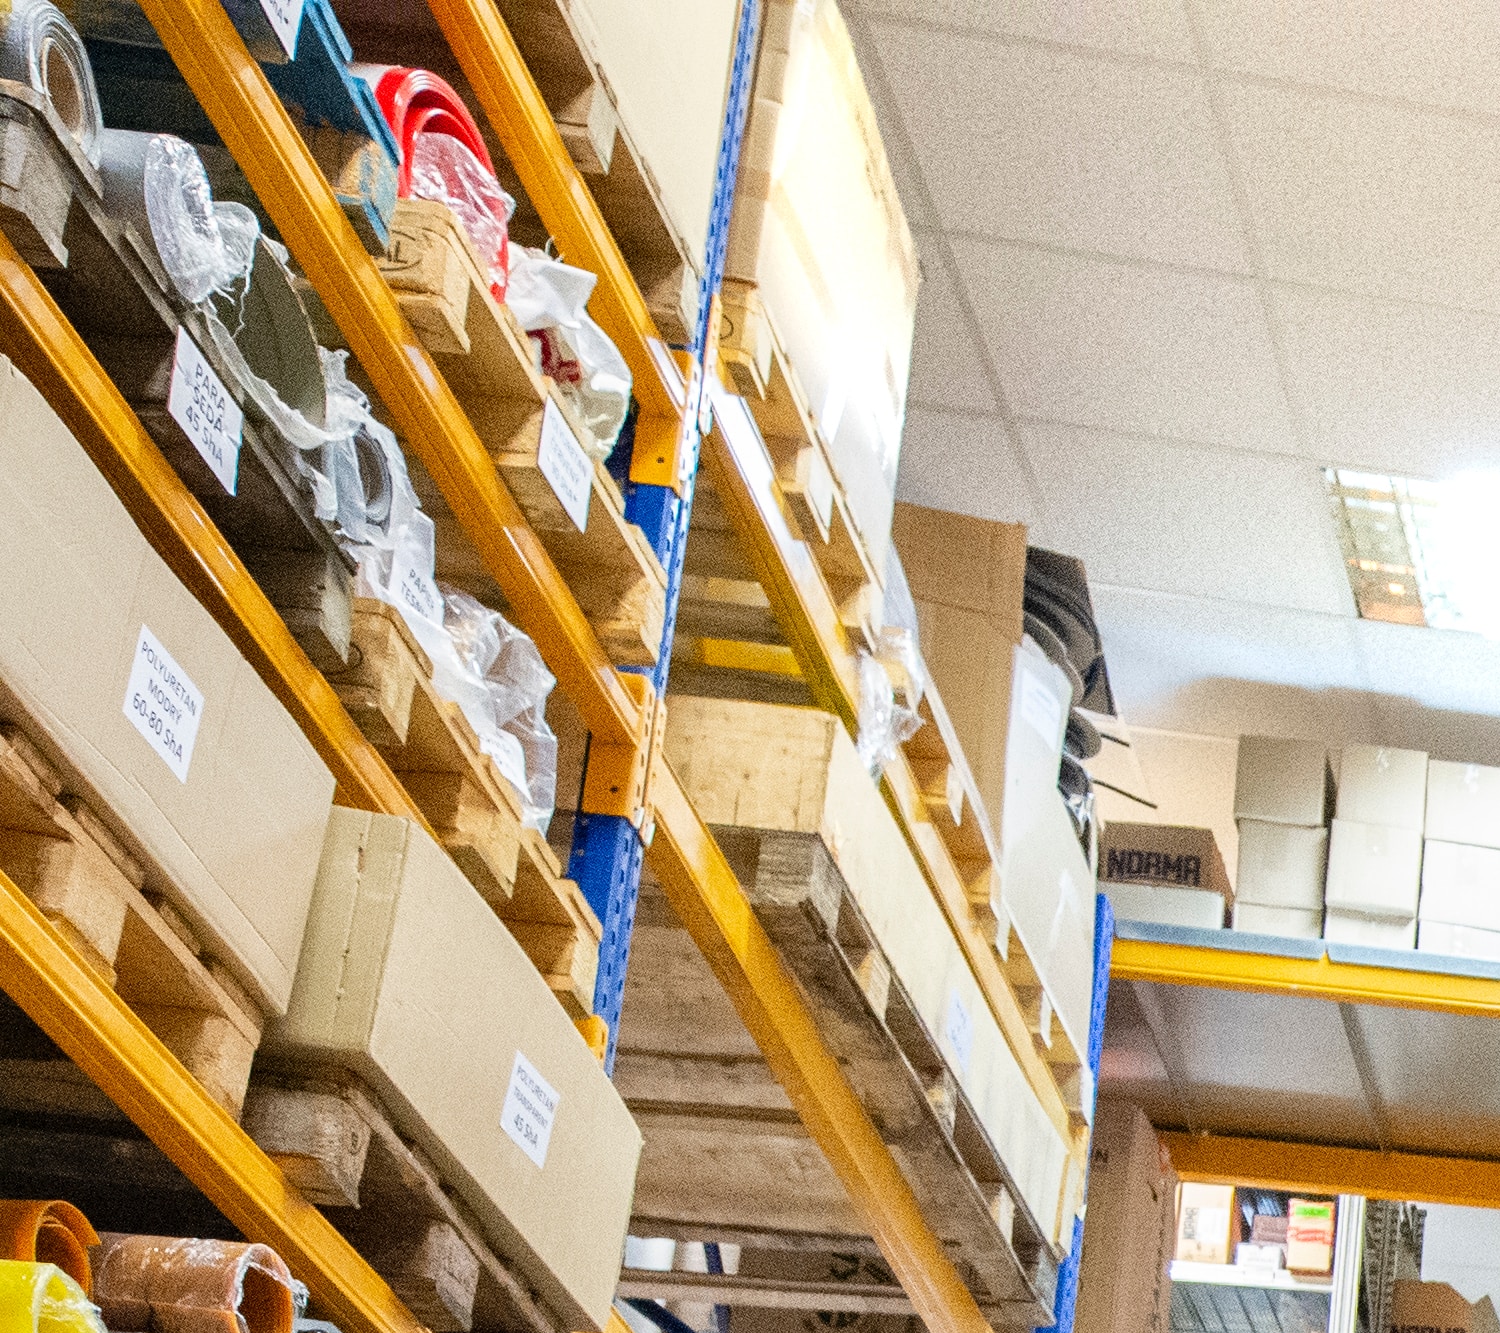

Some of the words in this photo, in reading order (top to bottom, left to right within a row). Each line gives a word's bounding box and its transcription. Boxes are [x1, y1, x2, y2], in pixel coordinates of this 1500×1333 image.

[196, 362, 226, 412] PARA
[186, 405, 200, 432] 45
[202, 424, 223, 466] ShA
[140, 638, 197, 718] POLYURETAN
[132, 689, 163, 737] 60-80
[163, 725, 184, 762] ShA
[1106, 849, 1202, 887] NORMA
